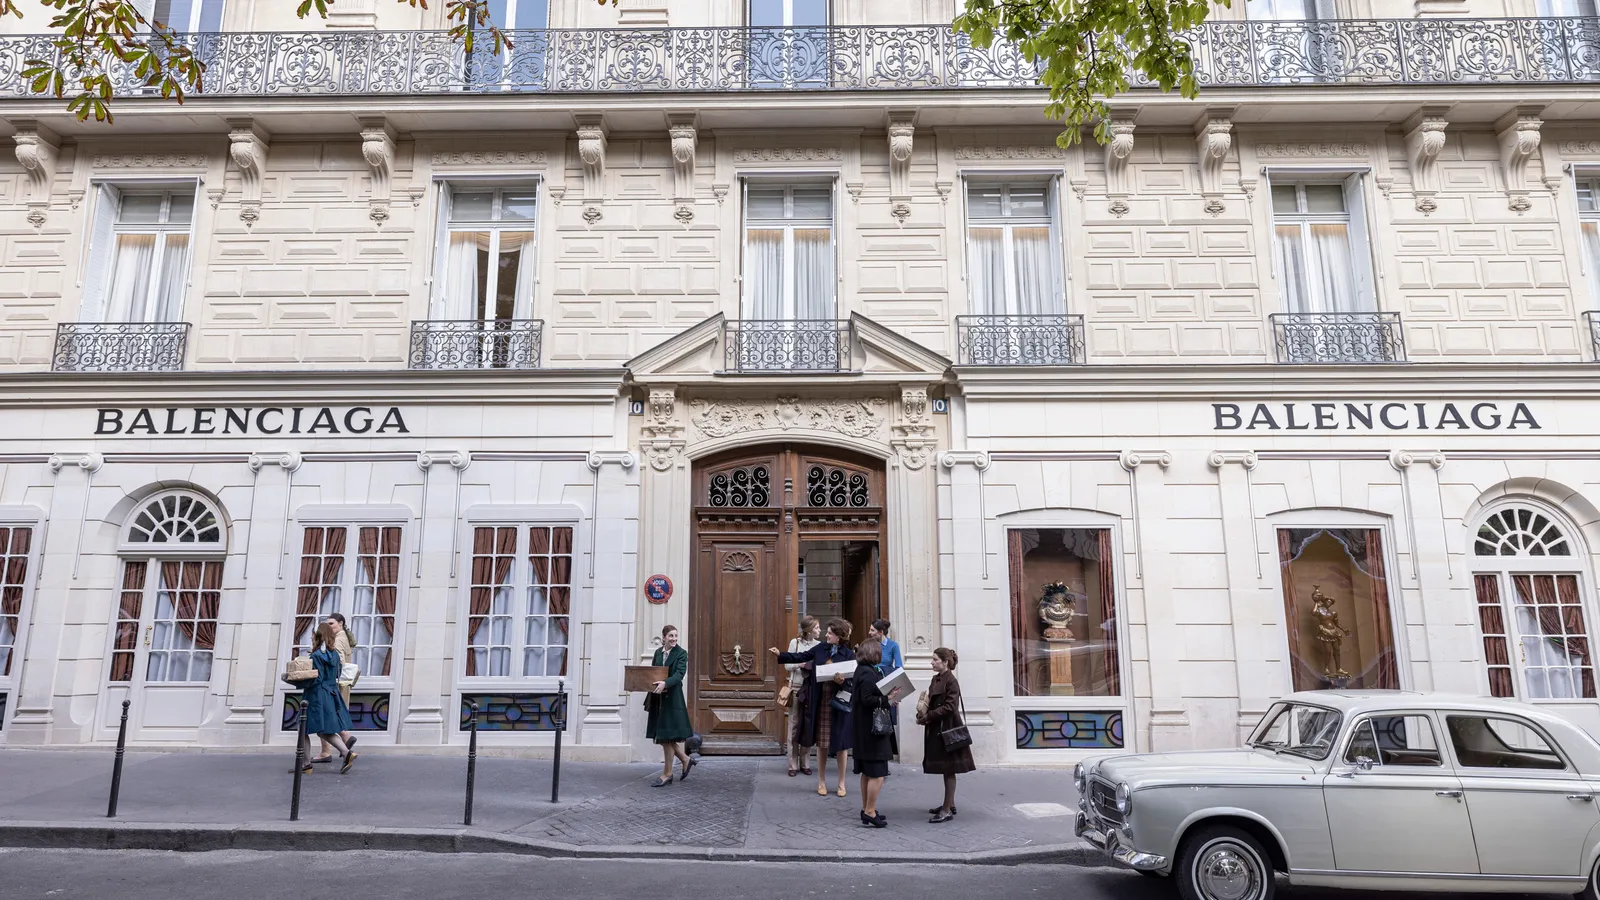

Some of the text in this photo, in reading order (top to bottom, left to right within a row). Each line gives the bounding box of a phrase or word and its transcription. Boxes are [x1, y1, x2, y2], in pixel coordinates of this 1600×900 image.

[933, 399, 945, 411] 10
[1211, 402, 1542, 430] BALENCIAGA
[94, 407, 410, 434] BALENCIAGA
